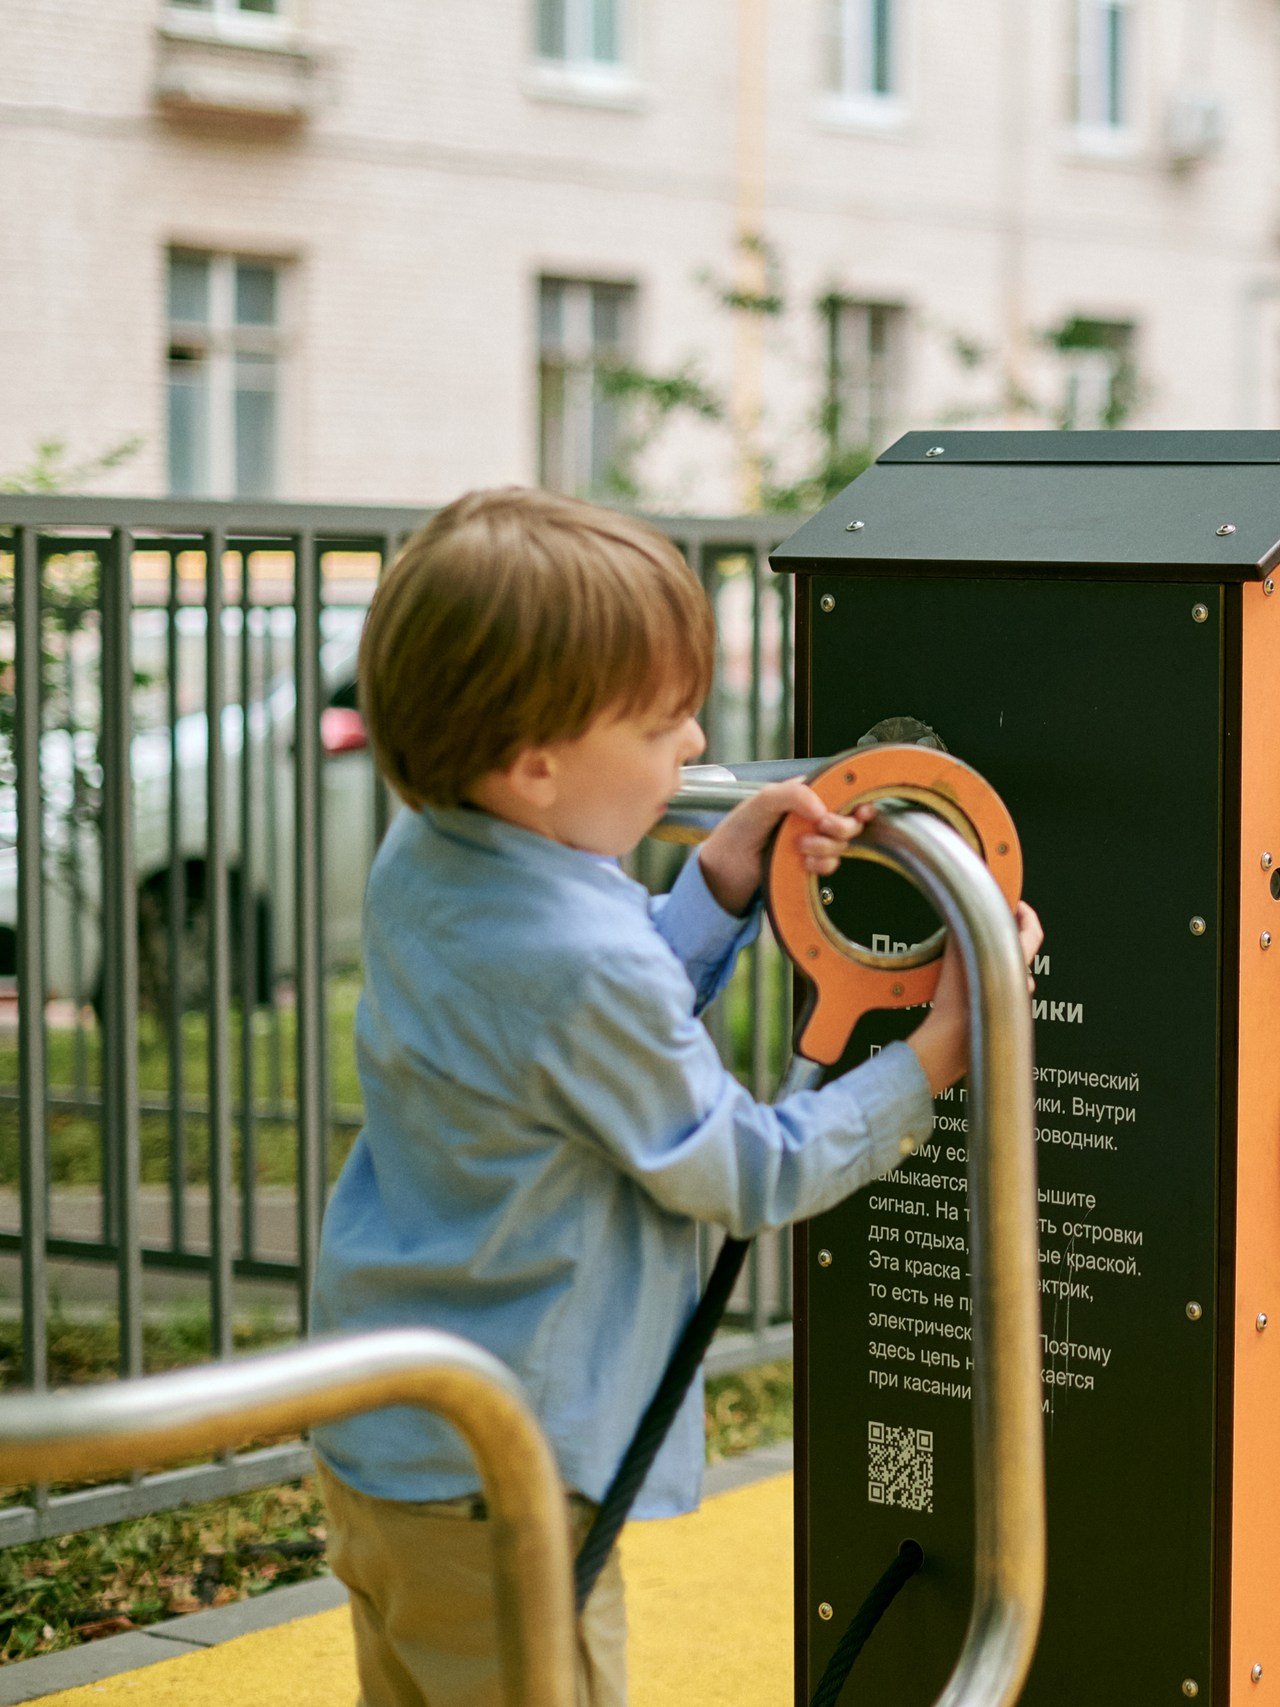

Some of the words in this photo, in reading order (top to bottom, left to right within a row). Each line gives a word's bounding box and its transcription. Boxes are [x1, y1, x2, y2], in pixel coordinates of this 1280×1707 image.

[1032, 1066, 1140, 1092] ектрический
[1072, 1096, 1136, 1125] Внутри
[871, 1169, 968, 1192] амыкается
[1037, 1188, 1096, 1209] ышите
[869, 1196, 930, 1217] сигнал.
[936, 1200, 959, 1221] На
[1062, 1222, 1143, 1246] островки
[868, 1225, 899, 1243] для
[904, 1230, 970, 1255] отдыха,
[1067, 1252, 1141, 1276] краской.
[869, 1249, 900, 1272] Эта
[905, 1259, 961, 1281] краска
[868, 1283, 887, 1298] то
[892, 1287, 929, 1305] есть
[934, 1292, 954, 1309] не
[868, 1312, 973, 1341] электрическ
[868, 1341, 916, 1361] здесь
[921, 1349, 961, 1369] цепь
[869, 1370, 898, 1389] при
[903, 1375, 972, 1400] касании
